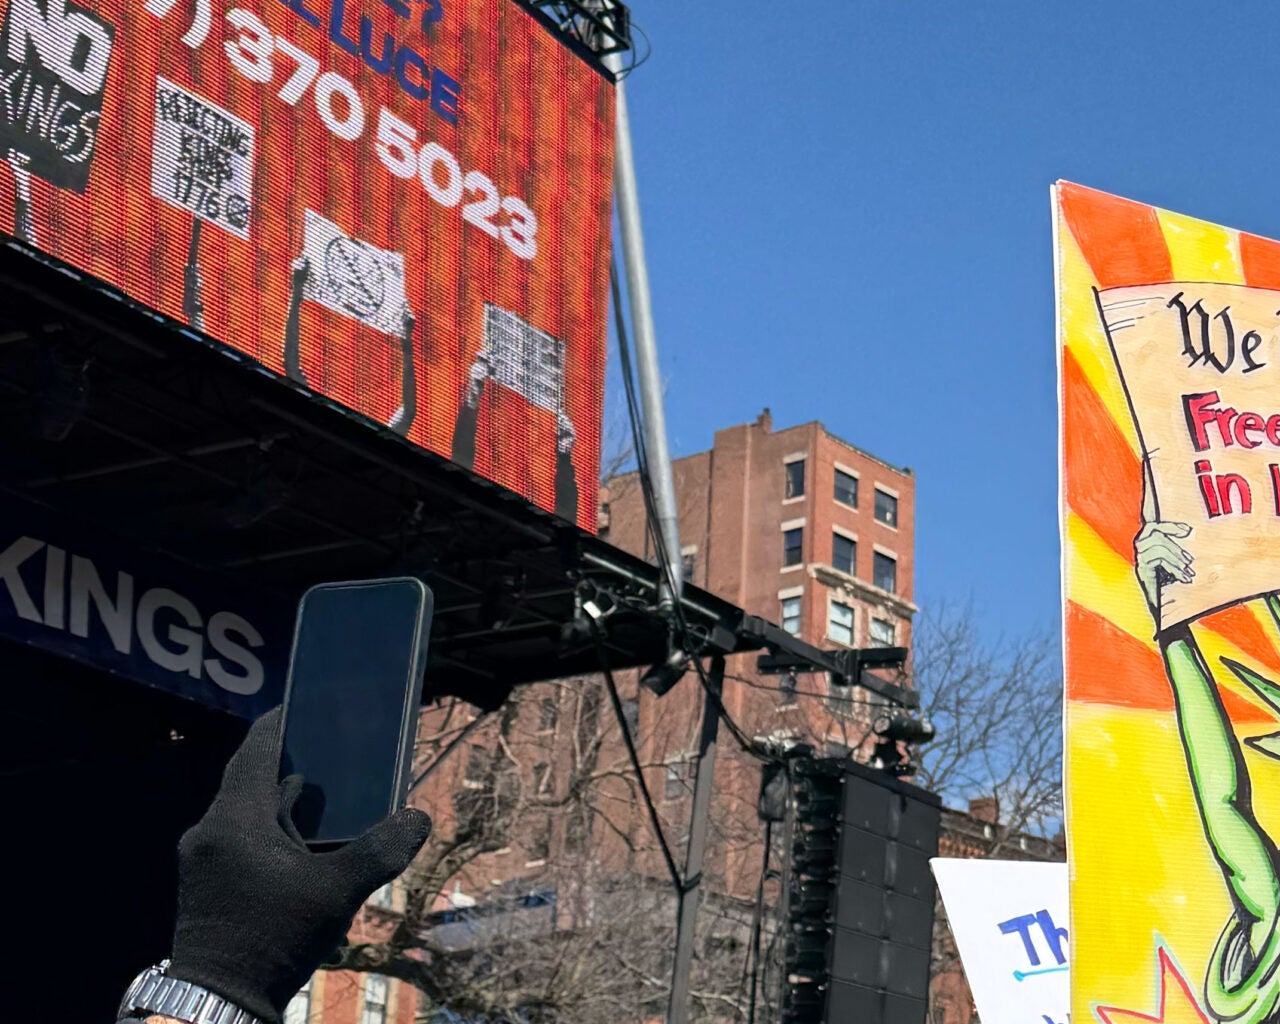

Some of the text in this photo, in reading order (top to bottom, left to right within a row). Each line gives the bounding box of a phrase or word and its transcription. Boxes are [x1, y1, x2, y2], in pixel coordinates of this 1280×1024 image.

[7, 0, 112, 95] NO
[329, 0, 461, 127] LUCE
[223, 8, 538, 260] 370 5023
[1167, 292, 1266, 374] We
[1194, 459, 1251, 519] in
[0, 536, 265, 695] KINGS
